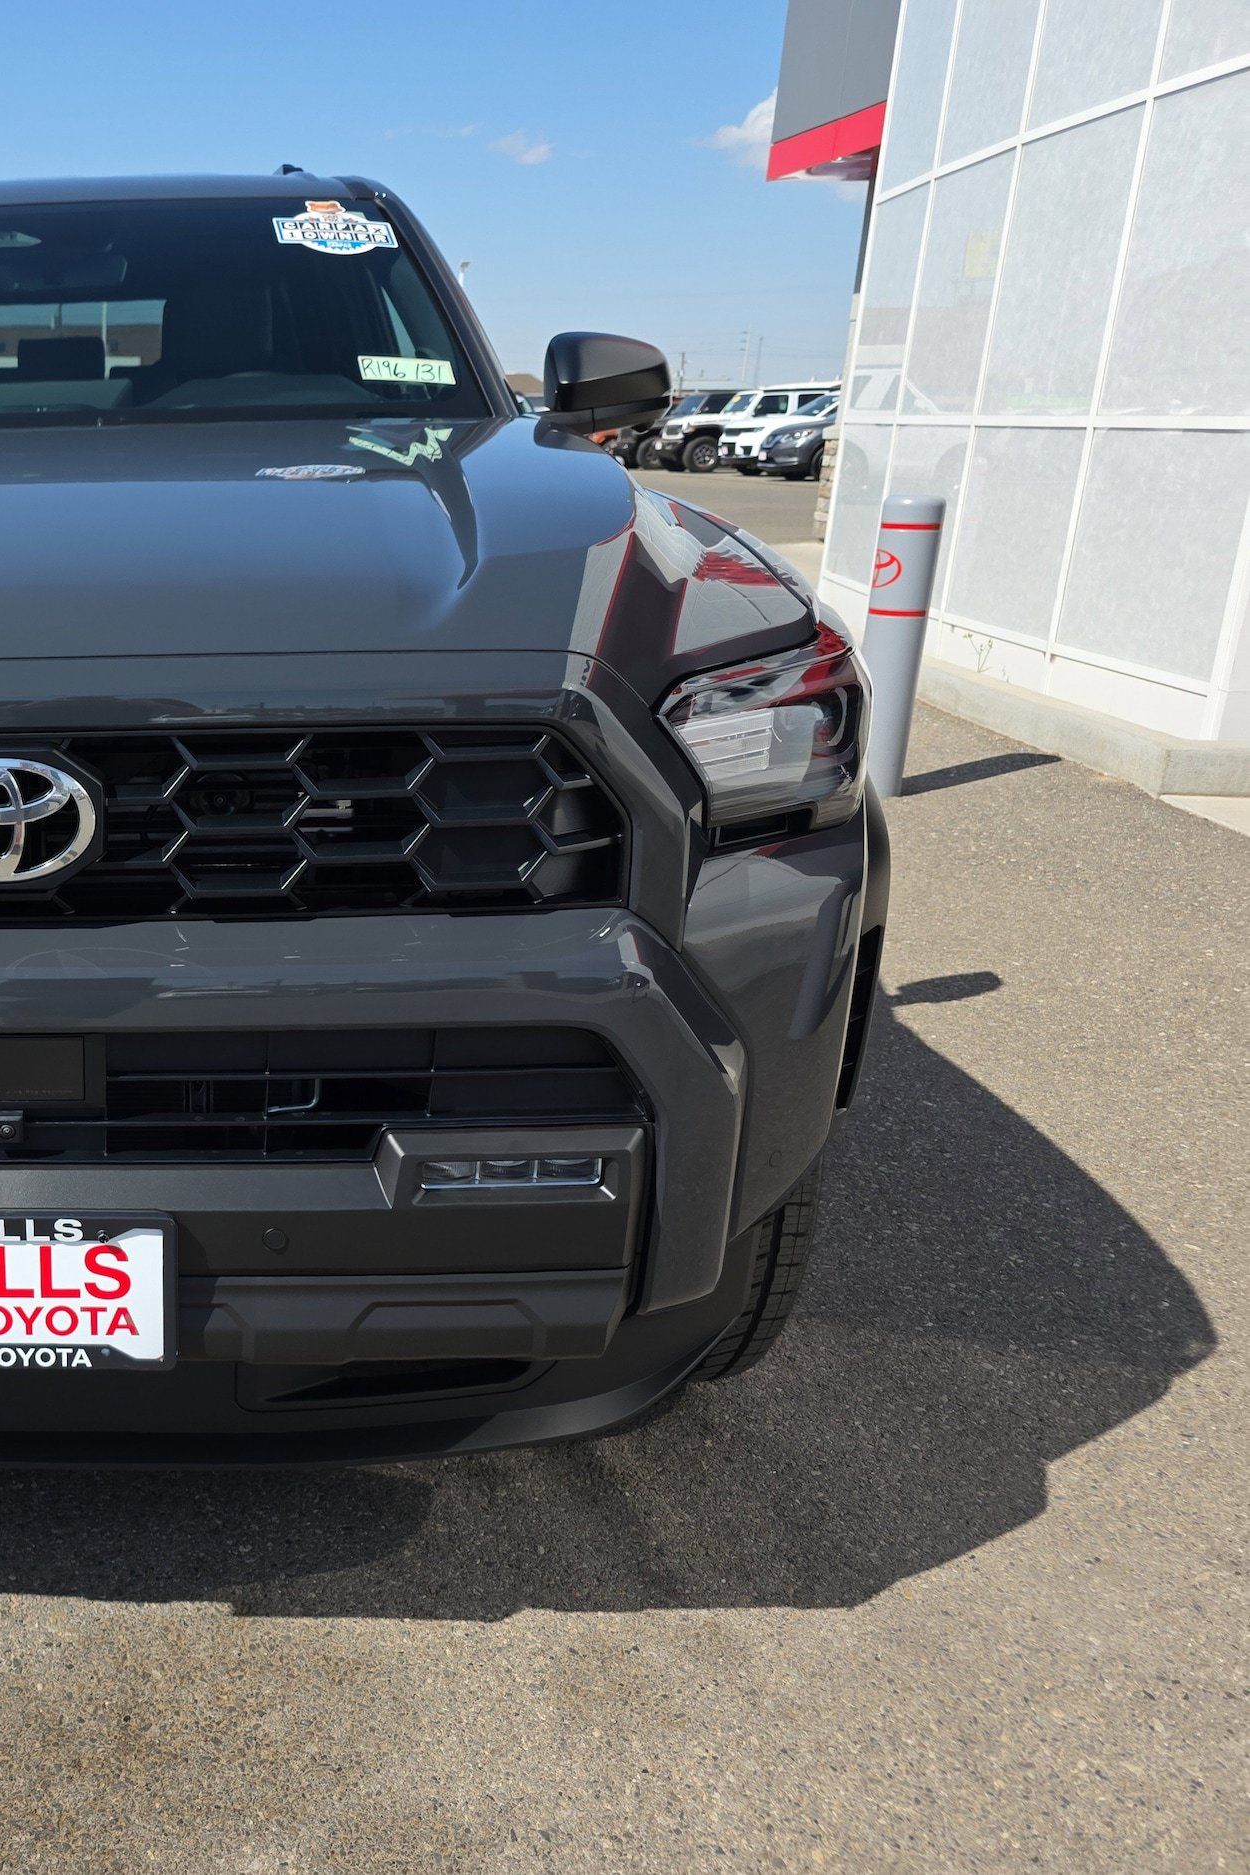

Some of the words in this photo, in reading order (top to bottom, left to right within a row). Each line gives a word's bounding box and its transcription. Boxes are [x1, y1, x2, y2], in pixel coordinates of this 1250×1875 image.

[283, 221, 385, 234] CARFAX
[302, 231, 390, 243] OWNER
[415, 363, 441, 382] 131
